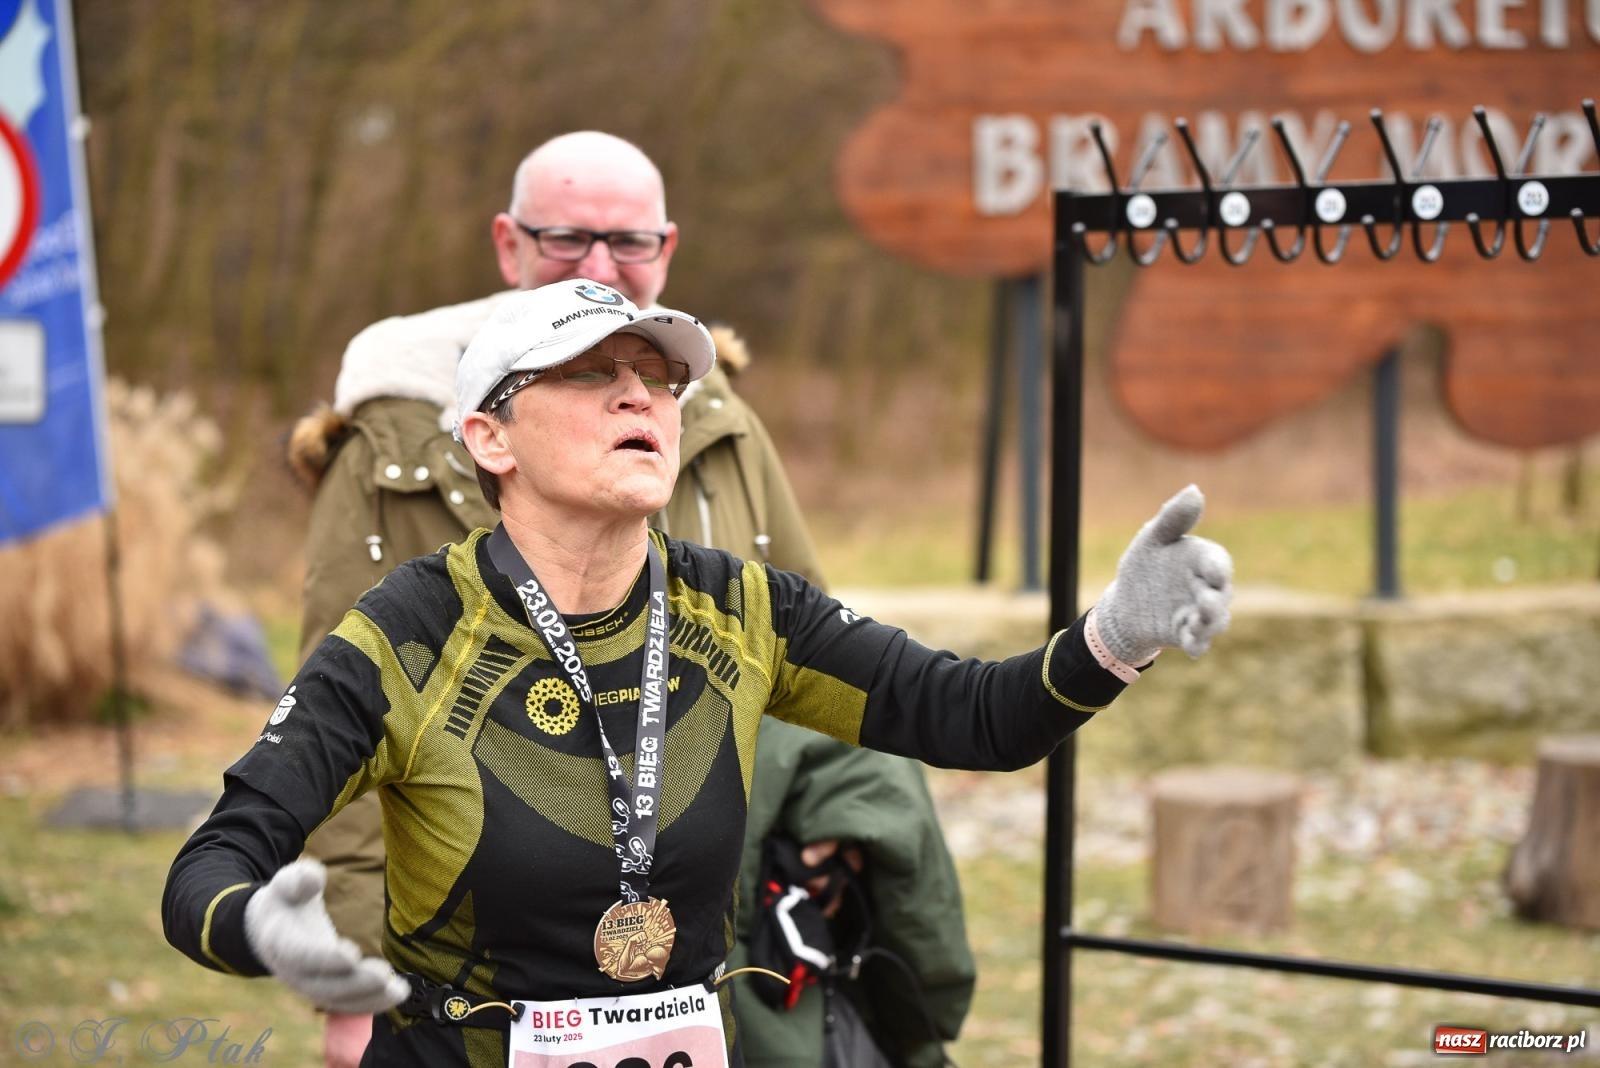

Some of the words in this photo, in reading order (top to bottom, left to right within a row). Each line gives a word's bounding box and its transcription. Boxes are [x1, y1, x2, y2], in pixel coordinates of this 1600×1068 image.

[1116, 0, 1600, 53] ARBORET
[516, 578, 593, 703] 23.02.2025
[642, 590, 666, 727] TWARDZIELA
[637, 736, 659, 789] BIEG
[634, 794, 654, 819] 13
[602, 920, 614, 931] 13
[616, 915, 645, 928] BIEG
[602, 925, 645, 937] TWARDZIELA
[532, 1009, 582, 1029] BIEG
[588, 995, 706, 1026] Twardziela
[533, 1034, 543, 1043] 23
[543, 1034, 562, 1044] luty
[563, 1032, 583, 1042] 2025
